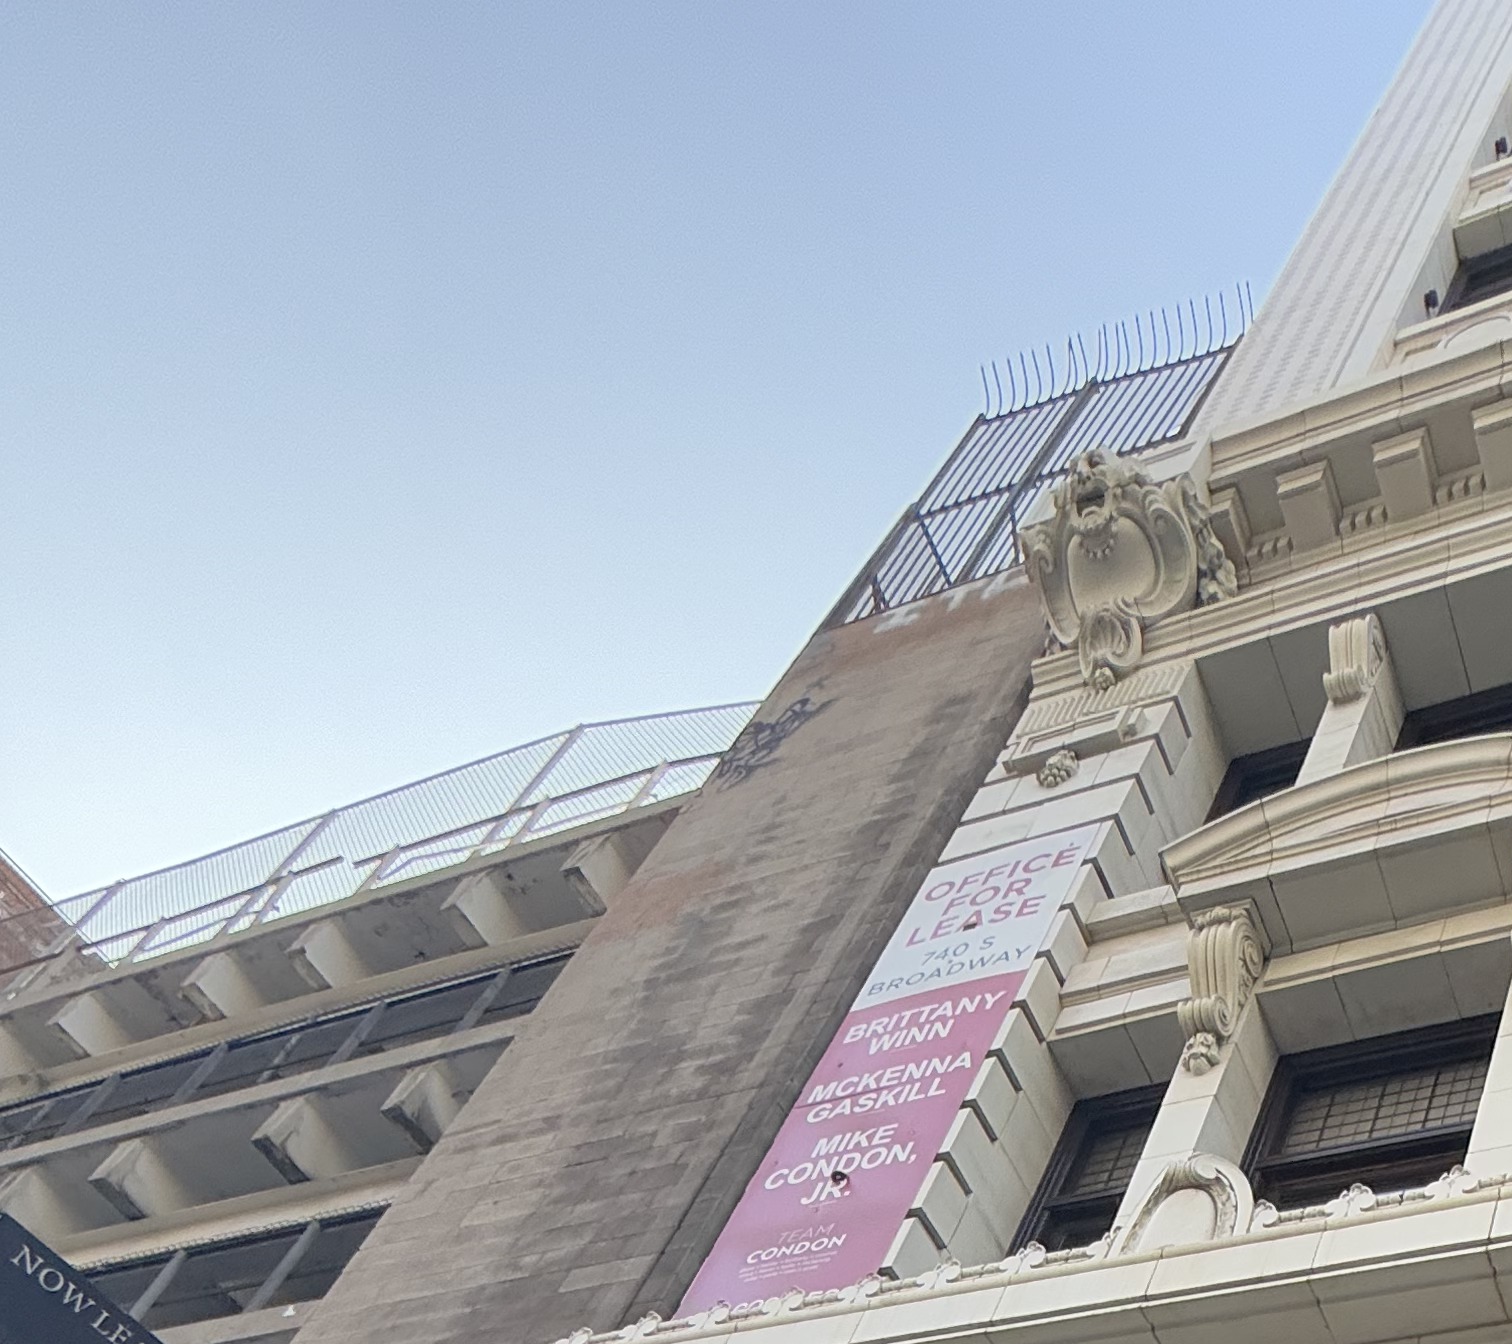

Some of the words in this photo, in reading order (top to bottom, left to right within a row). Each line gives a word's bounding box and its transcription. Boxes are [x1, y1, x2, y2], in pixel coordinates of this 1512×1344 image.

[924, 845, 1082, 902] OFFICE
[905, 894, 1047, 948] LEASE
[941, 878, 1032, 917] FOR
[867, 945, 1032, 997] BROADWAY
[922, 942, 969, 966] 740
[980, 936, 996, 950] S
[843, 990, 1008, 1044] BRITTANY
[868, 1018, 955, 1055] WINN
[805, 1077, 947, 1124] GASKILL
[807, 1051, 972, 1104] MCKENNA
[810, 1123, 898, 1159] MIKE
[763, 1141, 917, 1190] CONDON,
[800, 1176, 851, 1205] JR.
[746, 1233, 848, 1264] CONDON
[778, 1222, 835, 1245] TEAM
[10, 1244, 96, 1314] NOW
